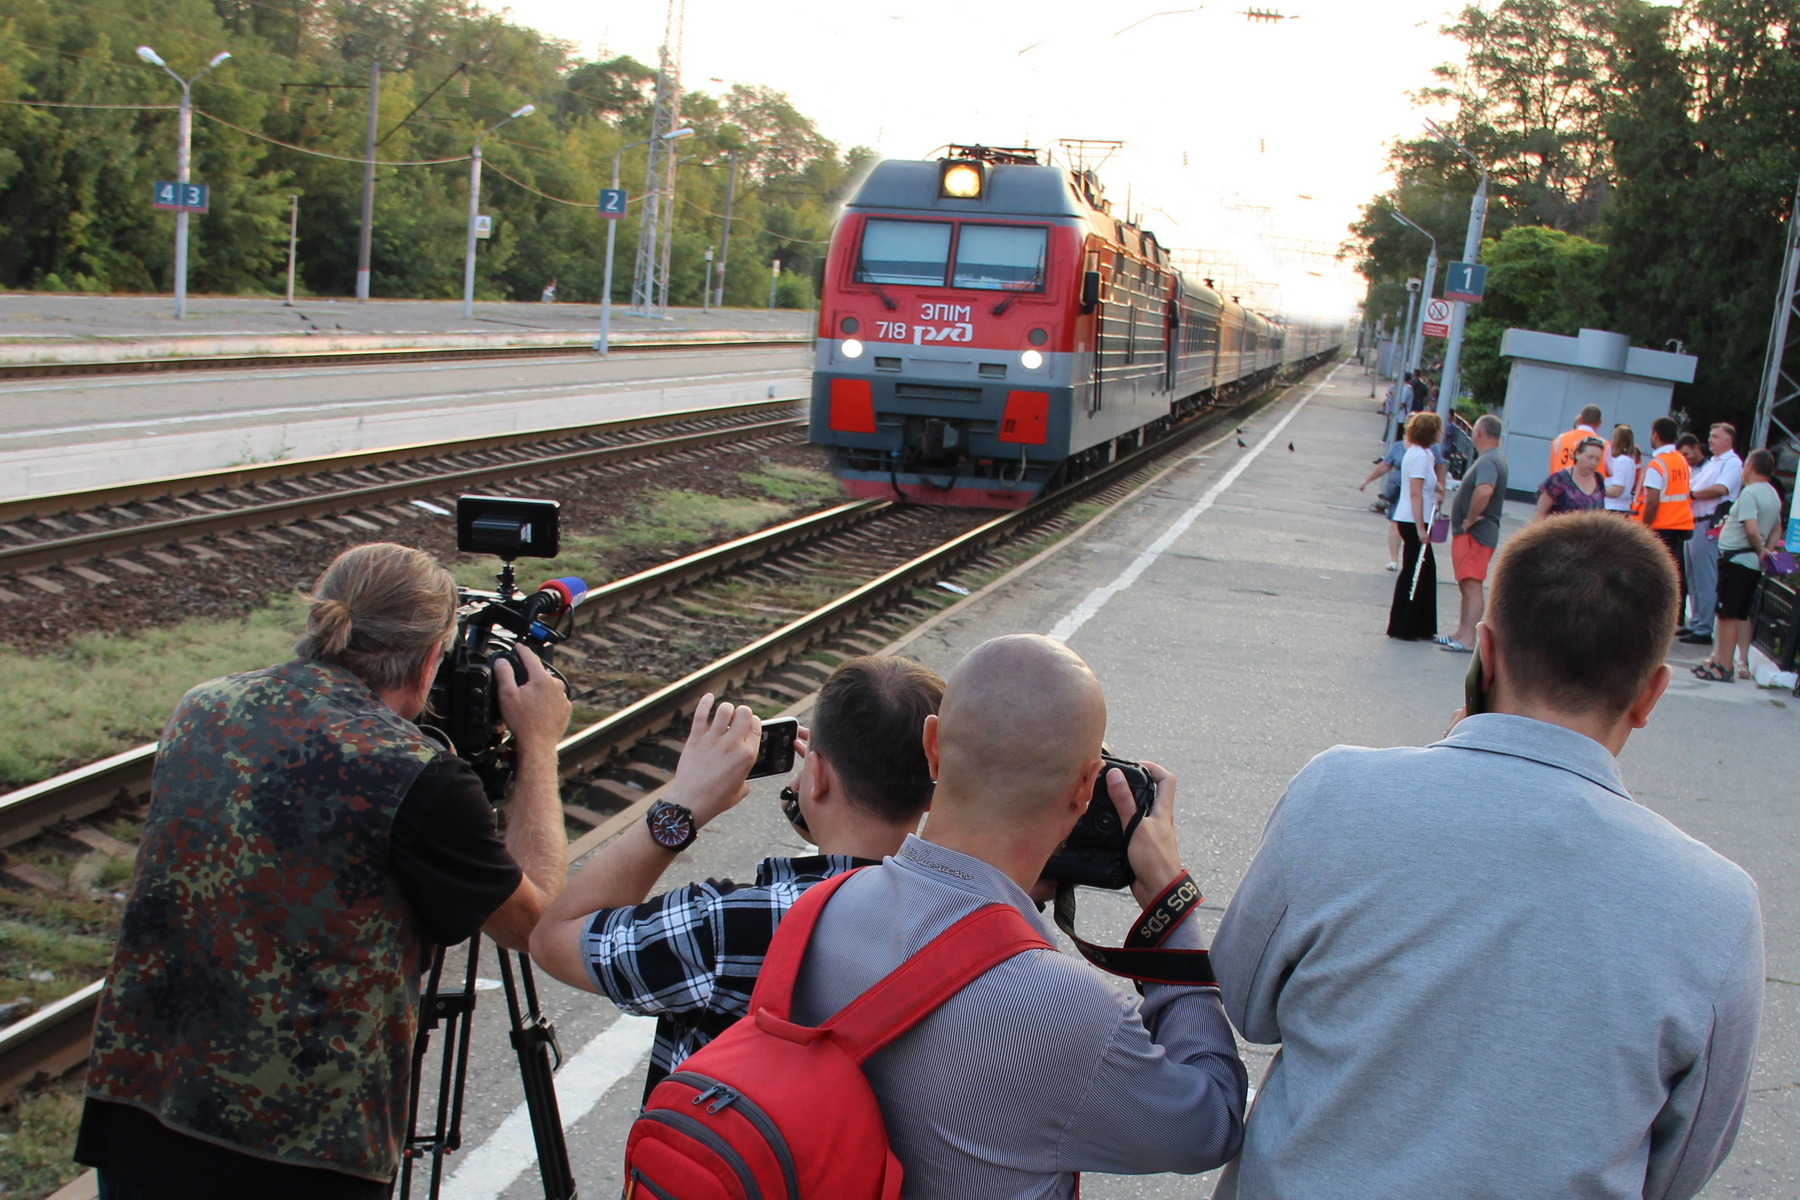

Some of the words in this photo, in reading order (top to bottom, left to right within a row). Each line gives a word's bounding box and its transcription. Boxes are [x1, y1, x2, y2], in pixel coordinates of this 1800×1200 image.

[160, 184, 174, 201] 4
[187, 186, 200, 204] 3
[606, 191, 619, 210] 2
[1463, 267, 1473, 290] 1
[876, 321, 906, 339] 718
[1167, 881, 1198, 912] EOS
